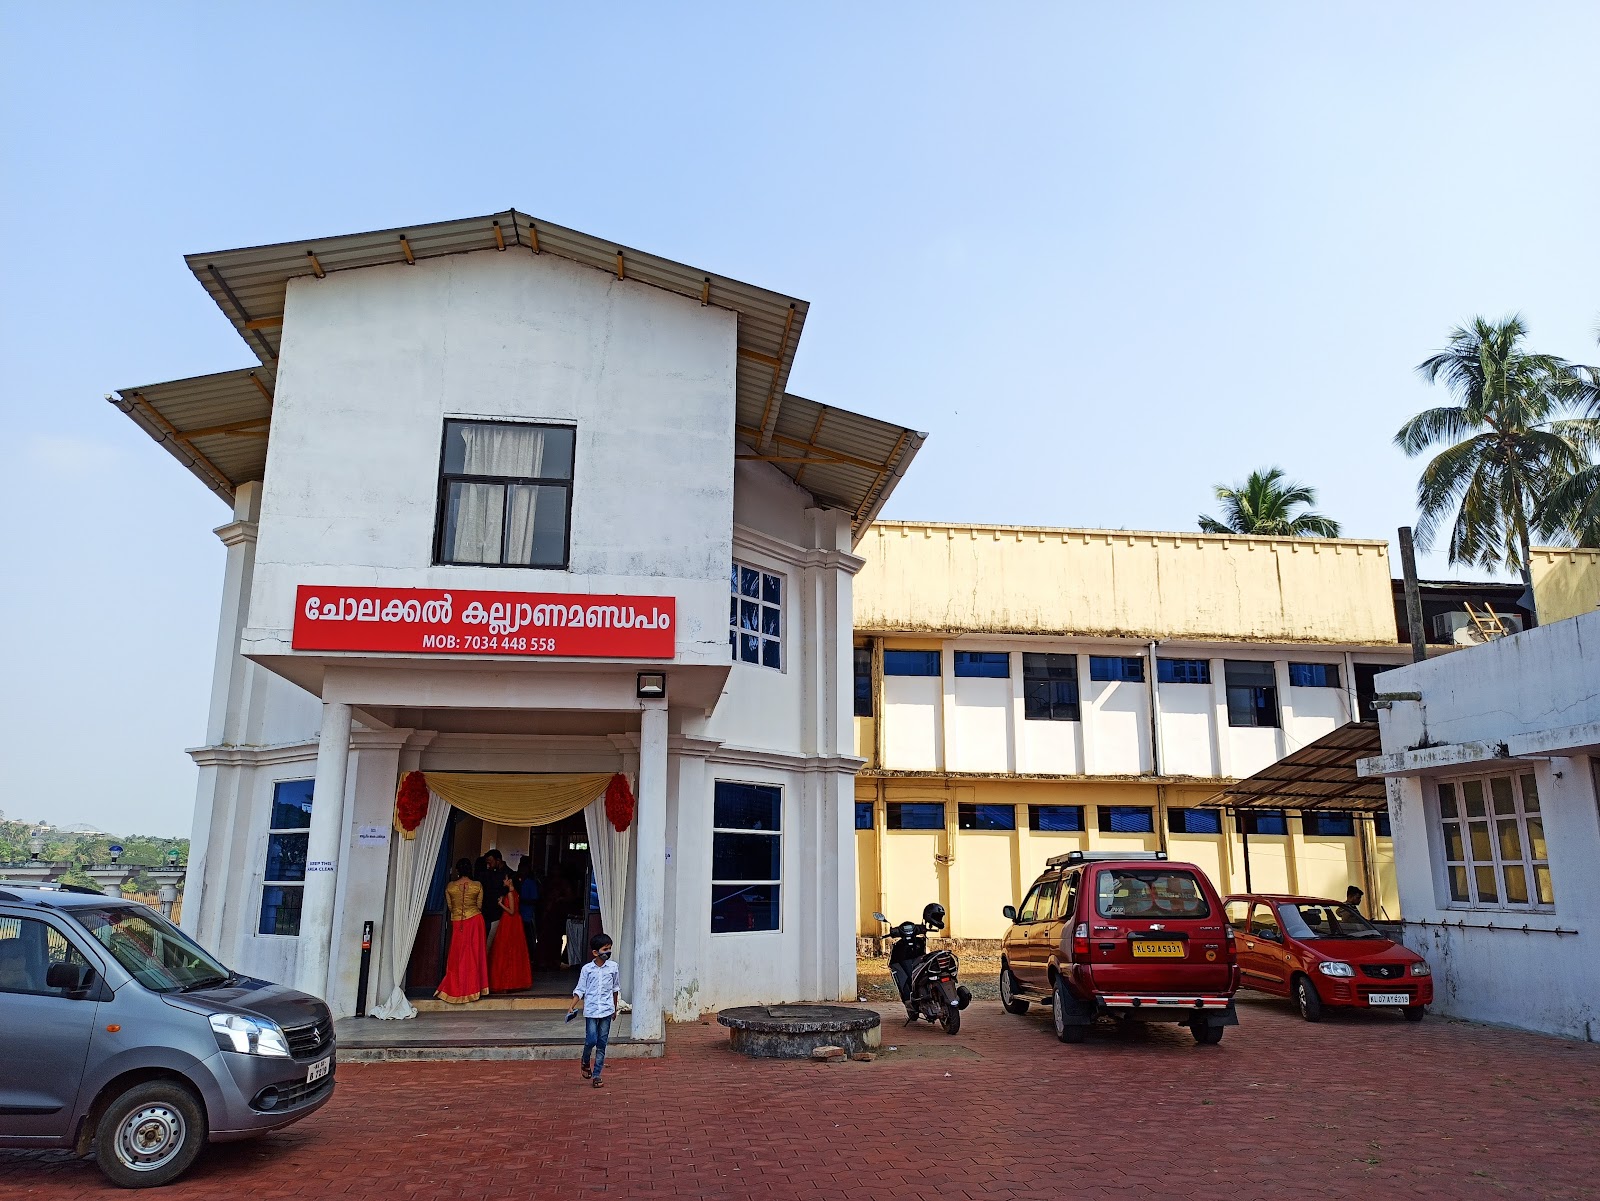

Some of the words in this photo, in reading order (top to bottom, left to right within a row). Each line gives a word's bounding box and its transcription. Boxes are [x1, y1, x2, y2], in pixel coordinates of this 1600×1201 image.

[305, 593, 453, 624] ചോലക്കൽ
[422, 634, 460, 649] MOB:
[464, 635, 498, 650] 7034
[501, 637, 527, 651] 448
[530, 638, 556, 652] 558
